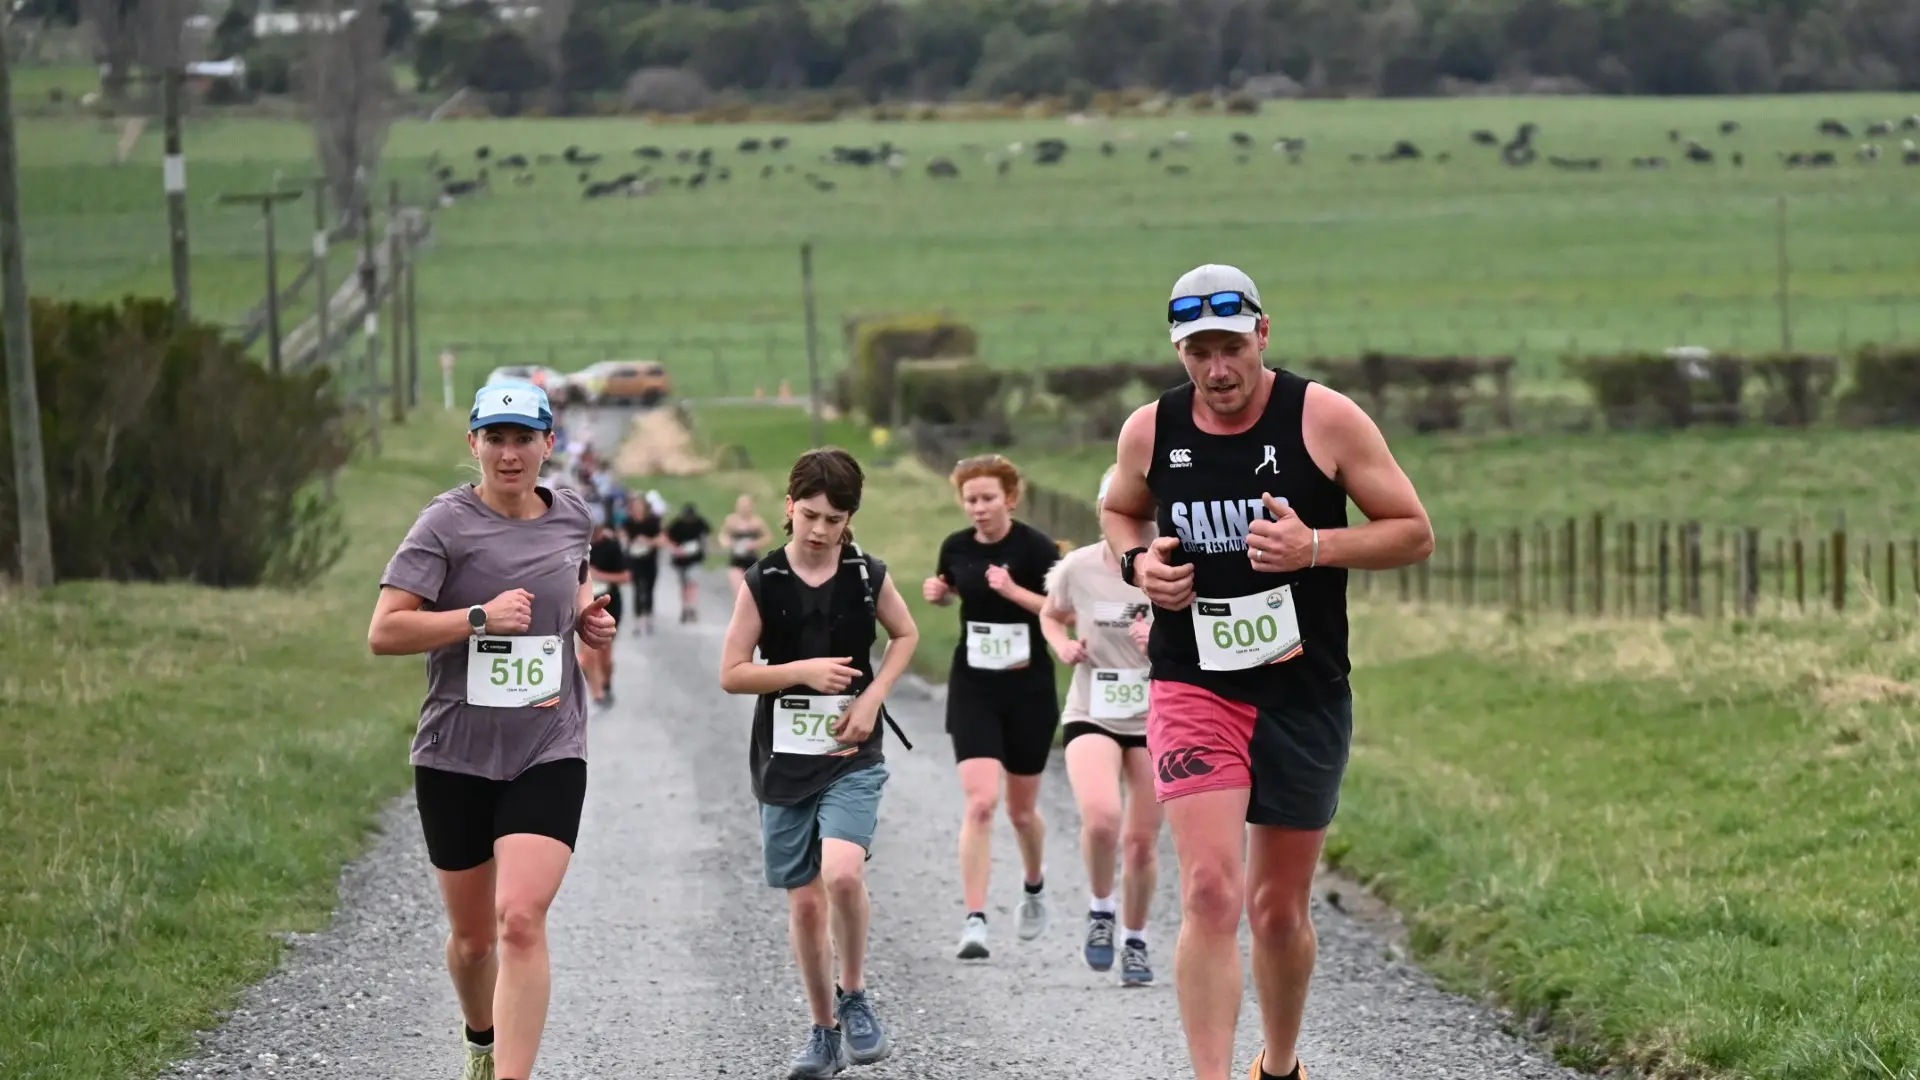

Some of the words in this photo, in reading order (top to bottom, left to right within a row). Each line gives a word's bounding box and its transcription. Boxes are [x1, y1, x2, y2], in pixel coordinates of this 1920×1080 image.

[1213, 614, 1277, 649] 600
[980, 637, 1011, 656] 611
[490, 658, 544, 686] 516
[1104, 684, 1144, 703] 593
